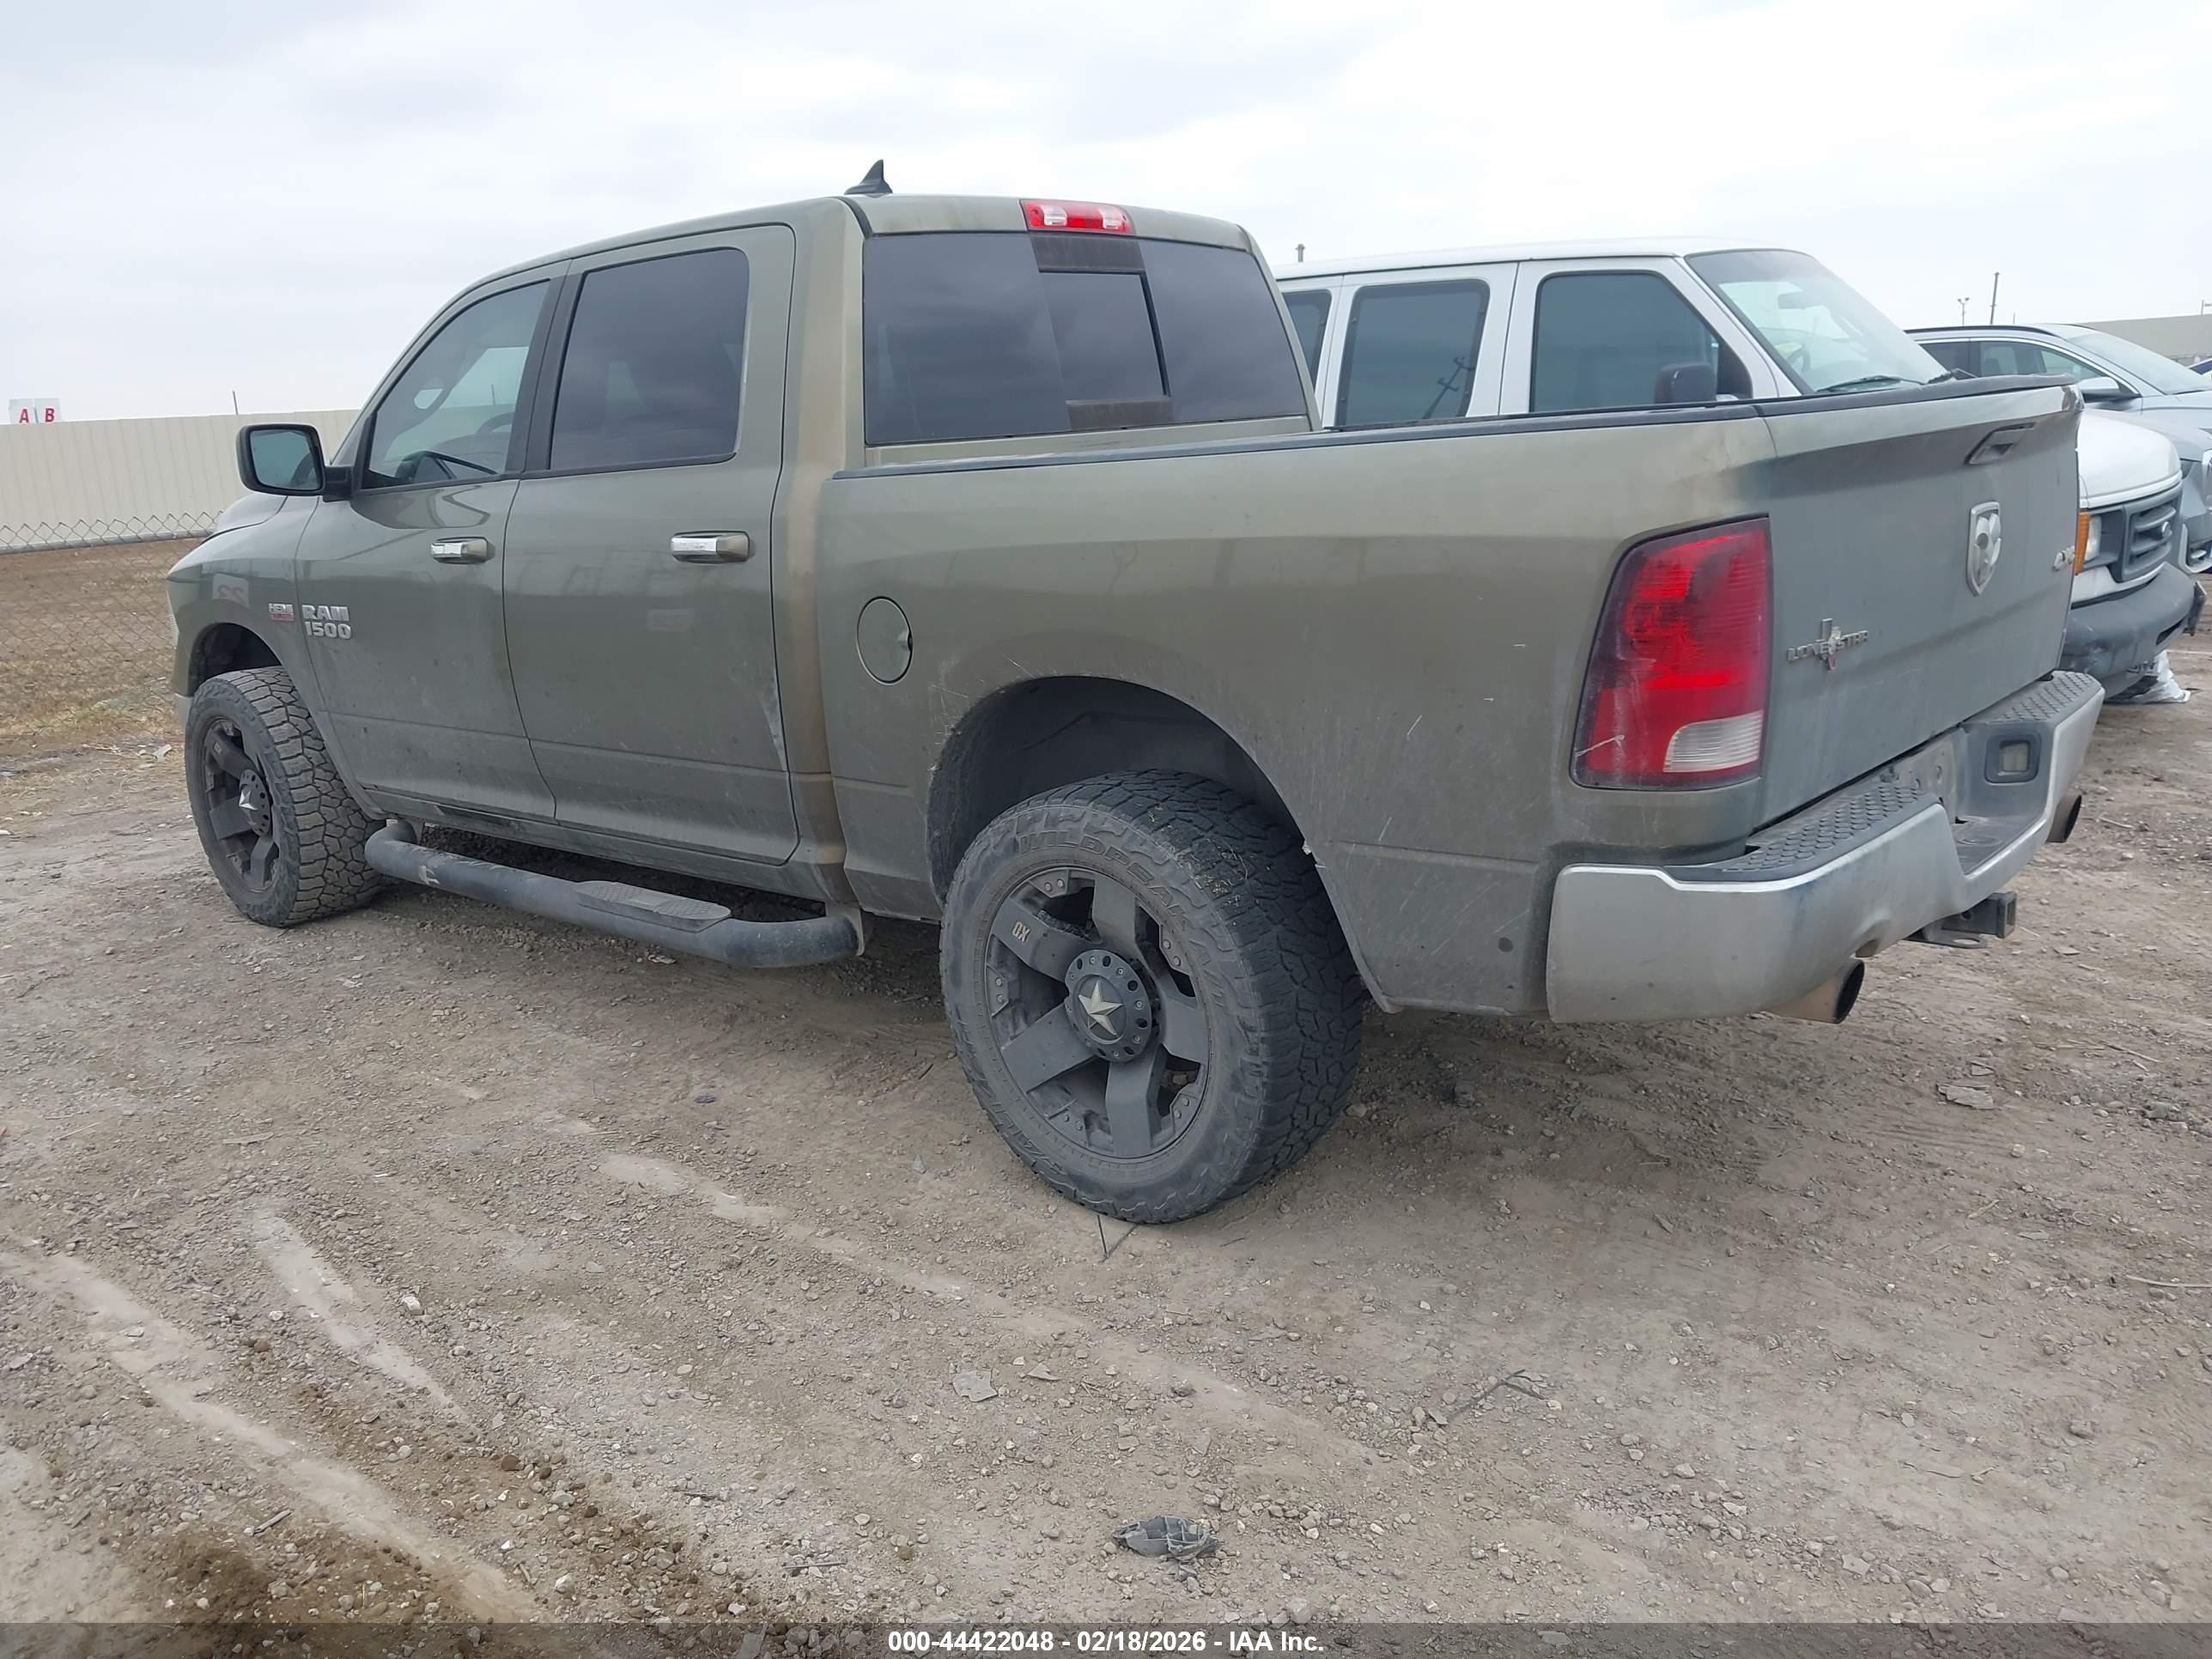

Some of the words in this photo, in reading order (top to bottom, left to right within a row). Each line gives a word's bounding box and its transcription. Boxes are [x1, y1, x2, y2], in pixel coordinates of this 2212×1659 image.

[19, 408, 29, 423] A
[45, 408, 55, 423] B
[301, 605, 349, 621] RAM
[304, 621, 351, 639] 1500
